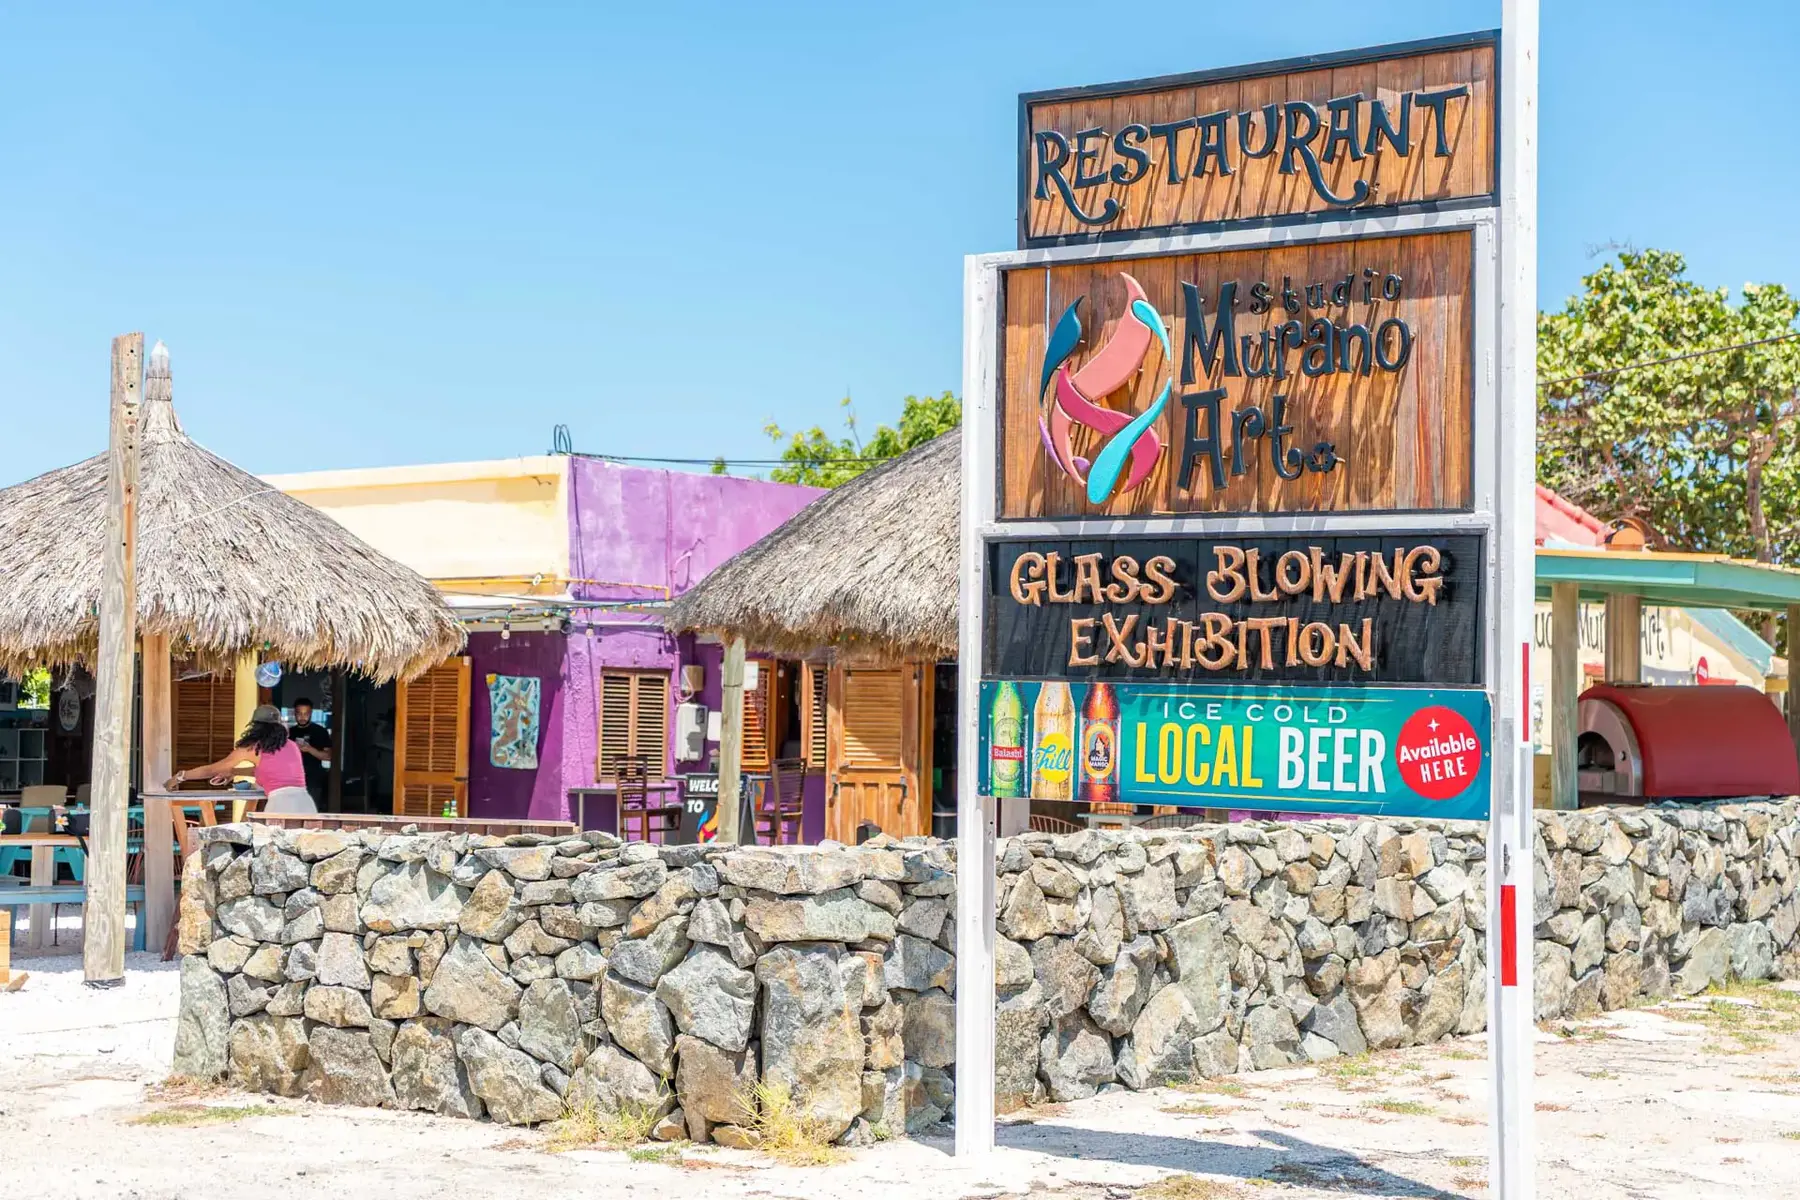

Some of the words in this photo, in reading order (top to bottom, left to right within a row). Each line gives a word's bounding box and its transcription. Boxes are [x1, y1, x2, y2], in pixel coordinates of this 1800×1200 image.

[1034, 86, 1470, 226] RESTAURANT
[1250, 267, 1402, 314] studio
[1181, 280, 1412, 385] Murano
[1010, 551, 1177, 607] GLASS
[1206, 546, 1443, 606] BLOWING
[1068, 612, 1373, 672] EXHIBITION
[1578, 603, 1605, 653] Mur
[1164, 702, 1222, 720] ICE
[1246, 704, 1348, 723] COLD
[1135, 722, 1263, 788] LOCAL
[1278, 727, 1387, 793] BEER
[1399, 732, 1477, 764] Available
[1421, 756, 1468, 784] HERE
[687, 799, 704, 813] TO
